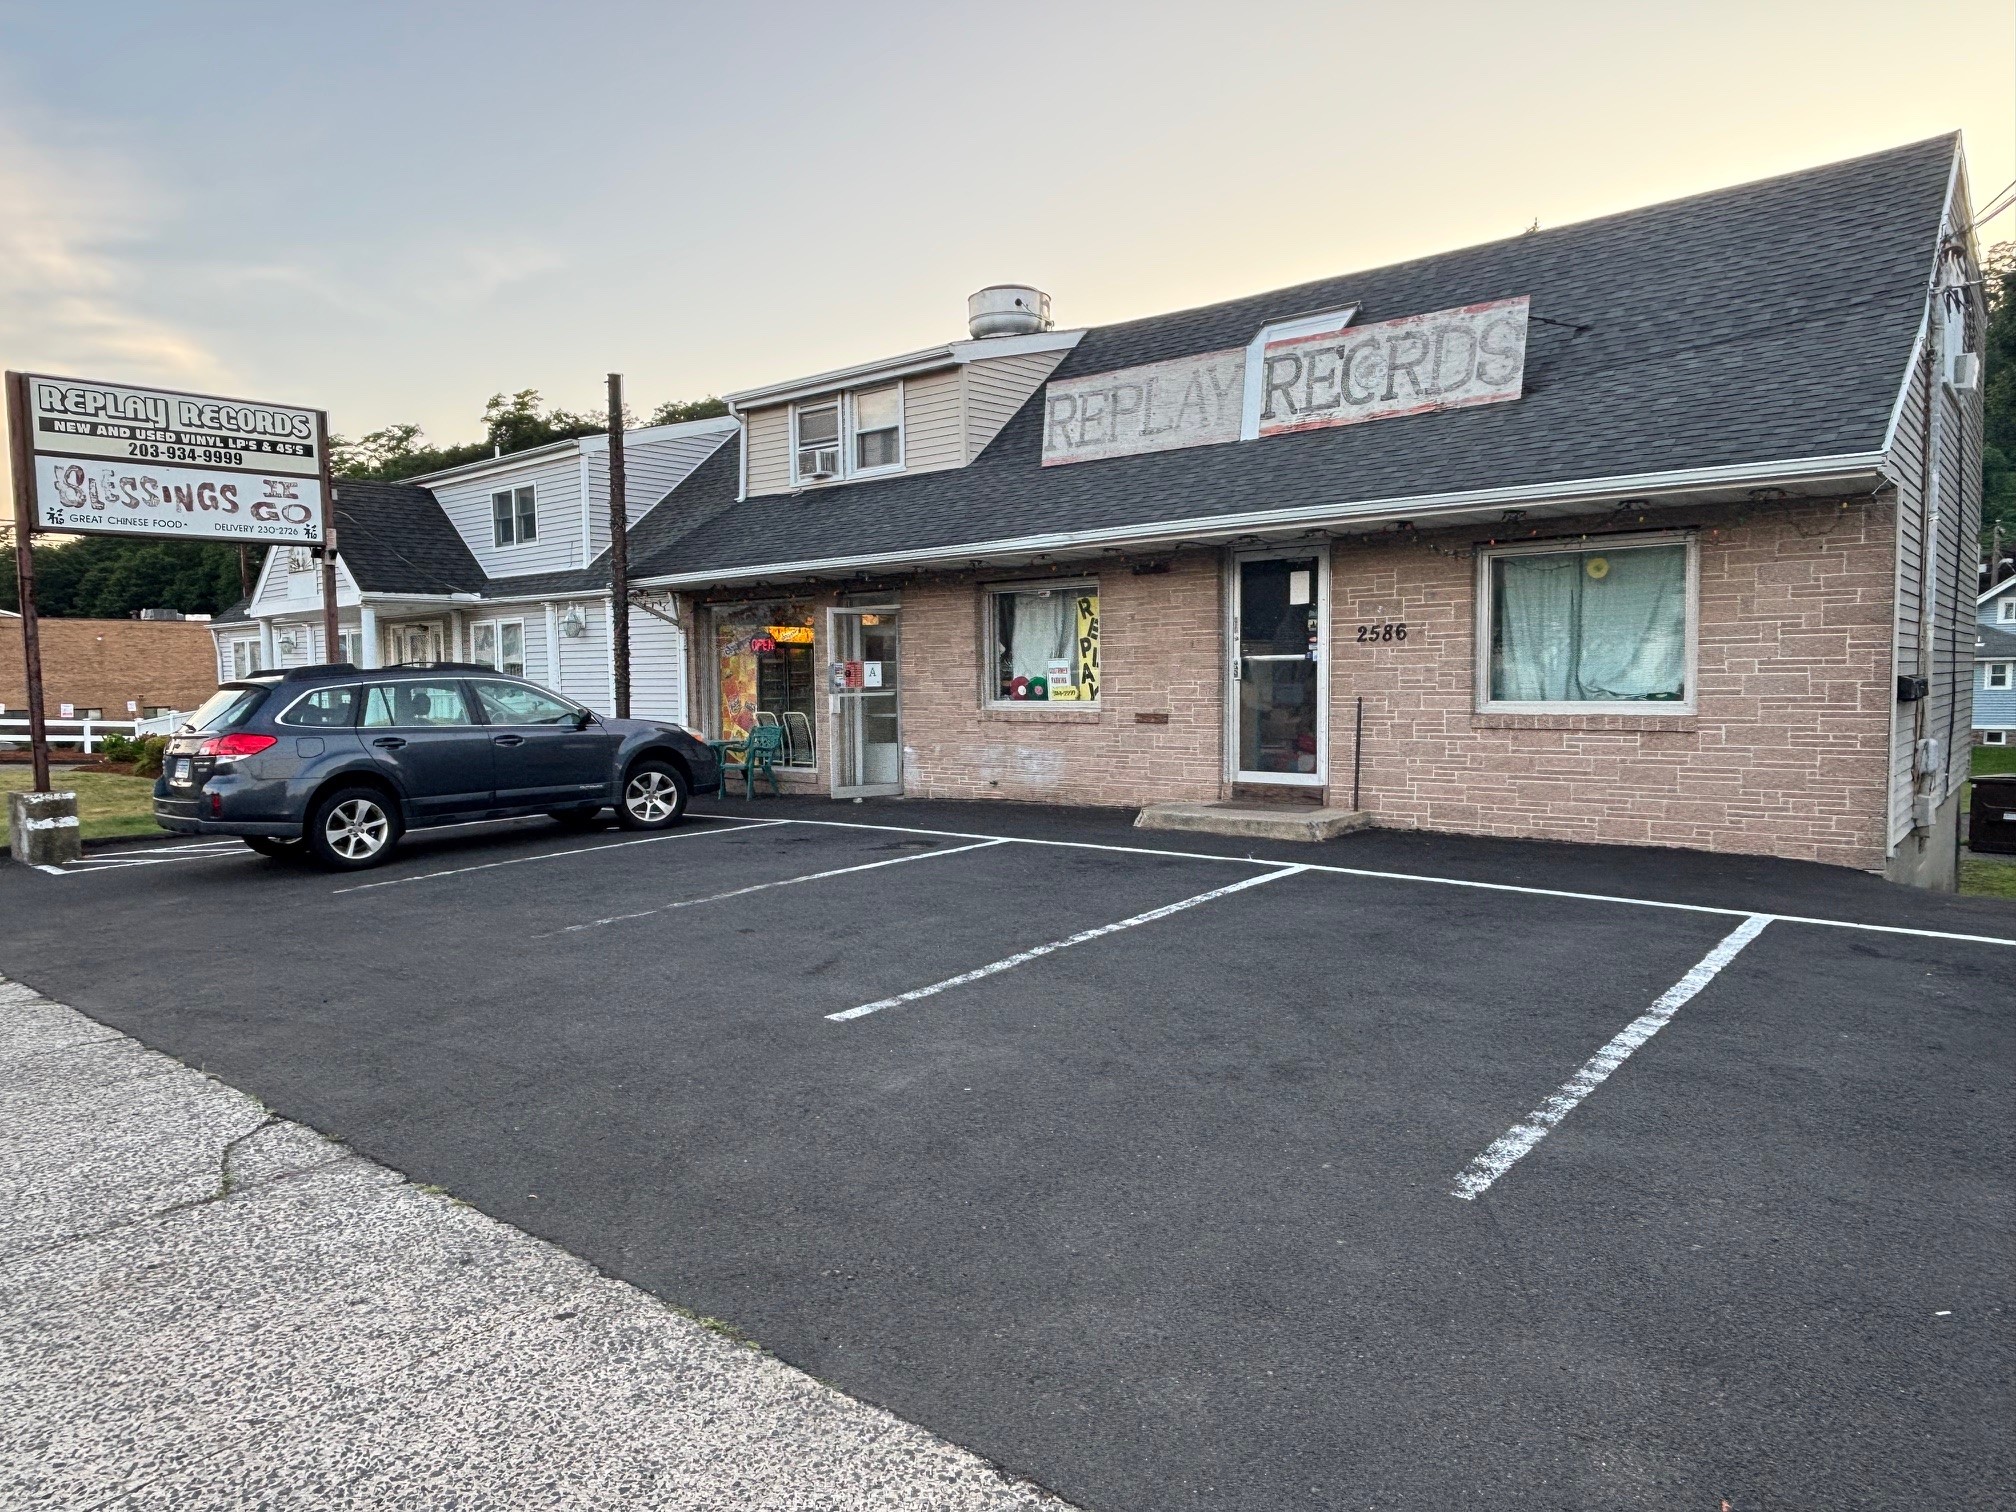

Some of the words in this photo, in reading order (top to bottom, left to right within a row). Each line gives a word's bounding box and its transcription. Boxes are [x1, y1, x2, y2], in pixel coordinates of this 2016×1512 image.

[38, 384, 170, 430] REPLAY
[178, 401, 312, 439] RECORDS
[1045, 363, 1245, 450] REPLAY
[54, 420, 91, 434] NEW
[97, 425, 130, 438] AND
[136, 429, 176, 442] USED
[180, 433, 224, 447] VINYL
[228, 438, 258, 450] LP'S
[262, 441, 271, 452] &
[276, 444, 304, 455] 45'S
[128, 442, 243, 465] 203-934-9999
[53, 464, 240, 514] BLESSINGS
[70, 514, 102, 524] GREAT
[108, 516, 149, 527] CHINESE
[250, 501, 312, 524] GO
[214, 523, 254, 533] DELIVERY
[258, 526, 299, 536] 230-2726
[1357, 623, 1407, 642] 2586
[752, 638, 775, 652] OPEN
[869, 667, 877, 677] A
